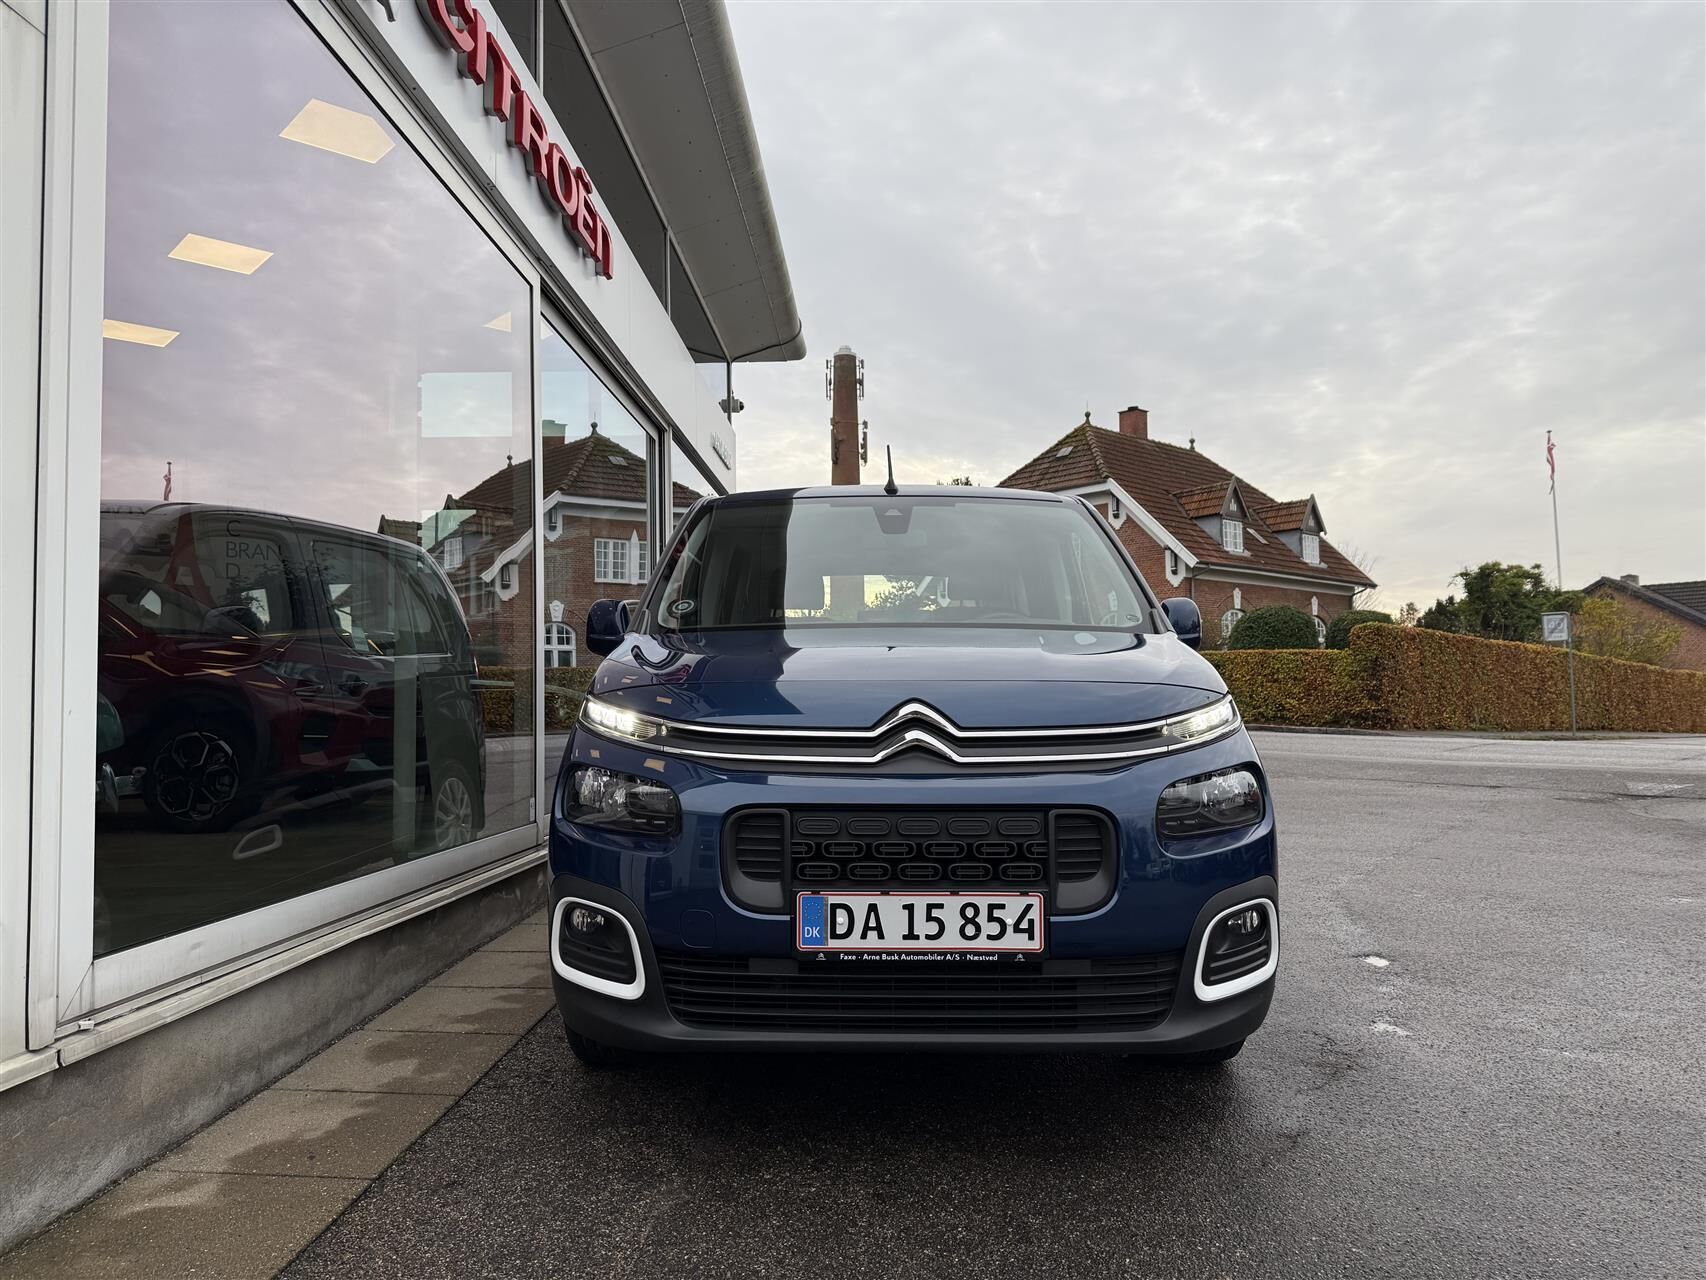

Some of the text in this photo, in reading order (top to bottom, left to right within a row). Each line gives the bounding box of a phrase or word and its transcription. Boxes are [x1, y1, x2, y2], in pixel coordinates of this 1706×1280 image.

[829, 902, 1036, 941] DA 15 854
[804, 926, 821, 938] DK
[946, 953, 960, 961] A/S
[967, 953, 998, 961] Næstved
